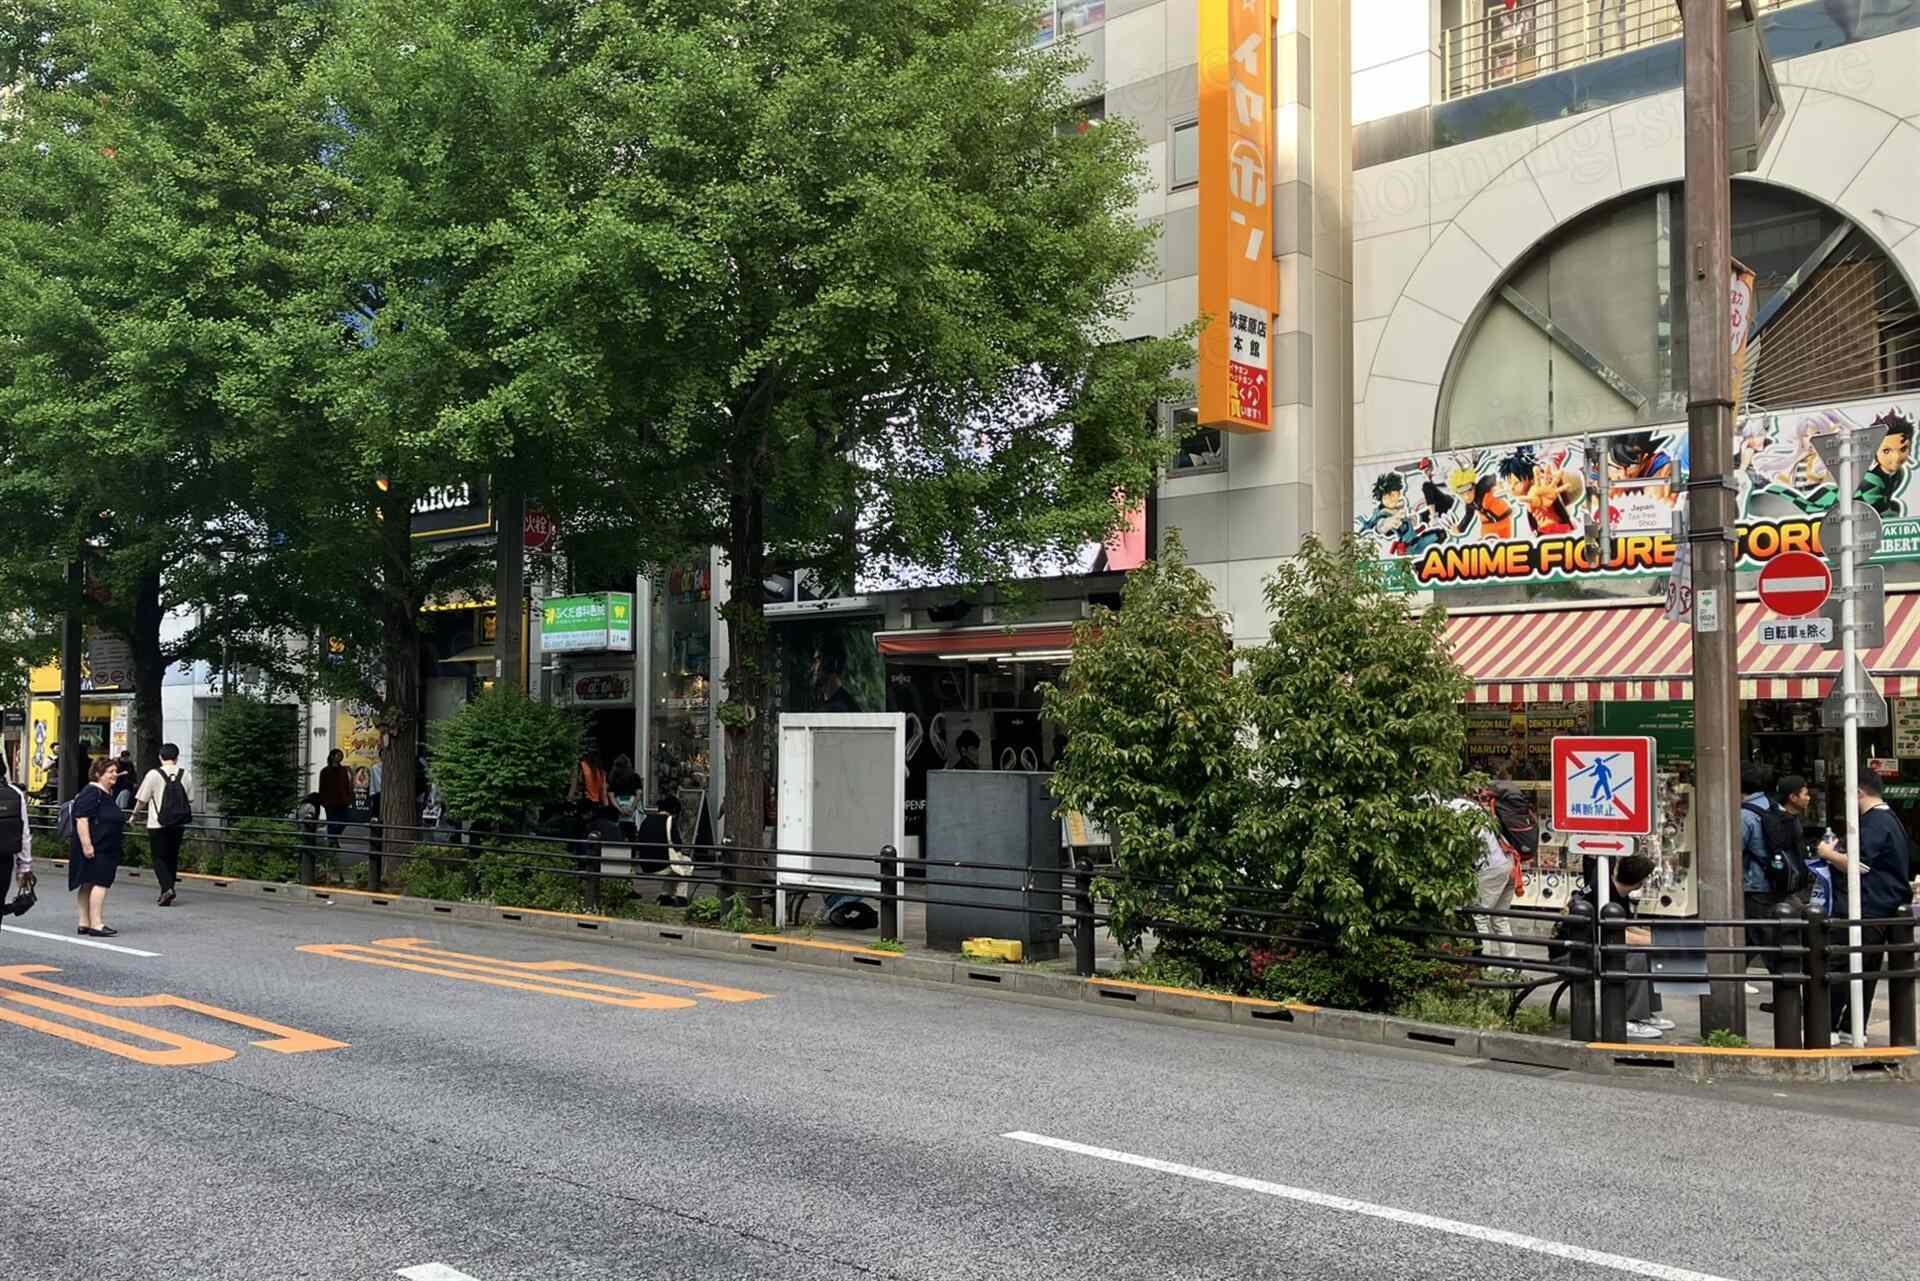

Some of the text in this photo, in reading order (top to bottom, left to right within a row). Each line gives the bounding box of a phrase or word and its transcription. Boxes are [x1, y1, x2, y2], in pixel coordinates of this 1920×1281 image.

[1230, 311, 1267, 339] 秋葉原店
[524, 514, 548, 535] 火栓
[1421, 545, 1531, 580] ANIME
[1763, 625, 1827, 641] 自転車を除く
[1570, 802, 1616, 817] 横断禁止
